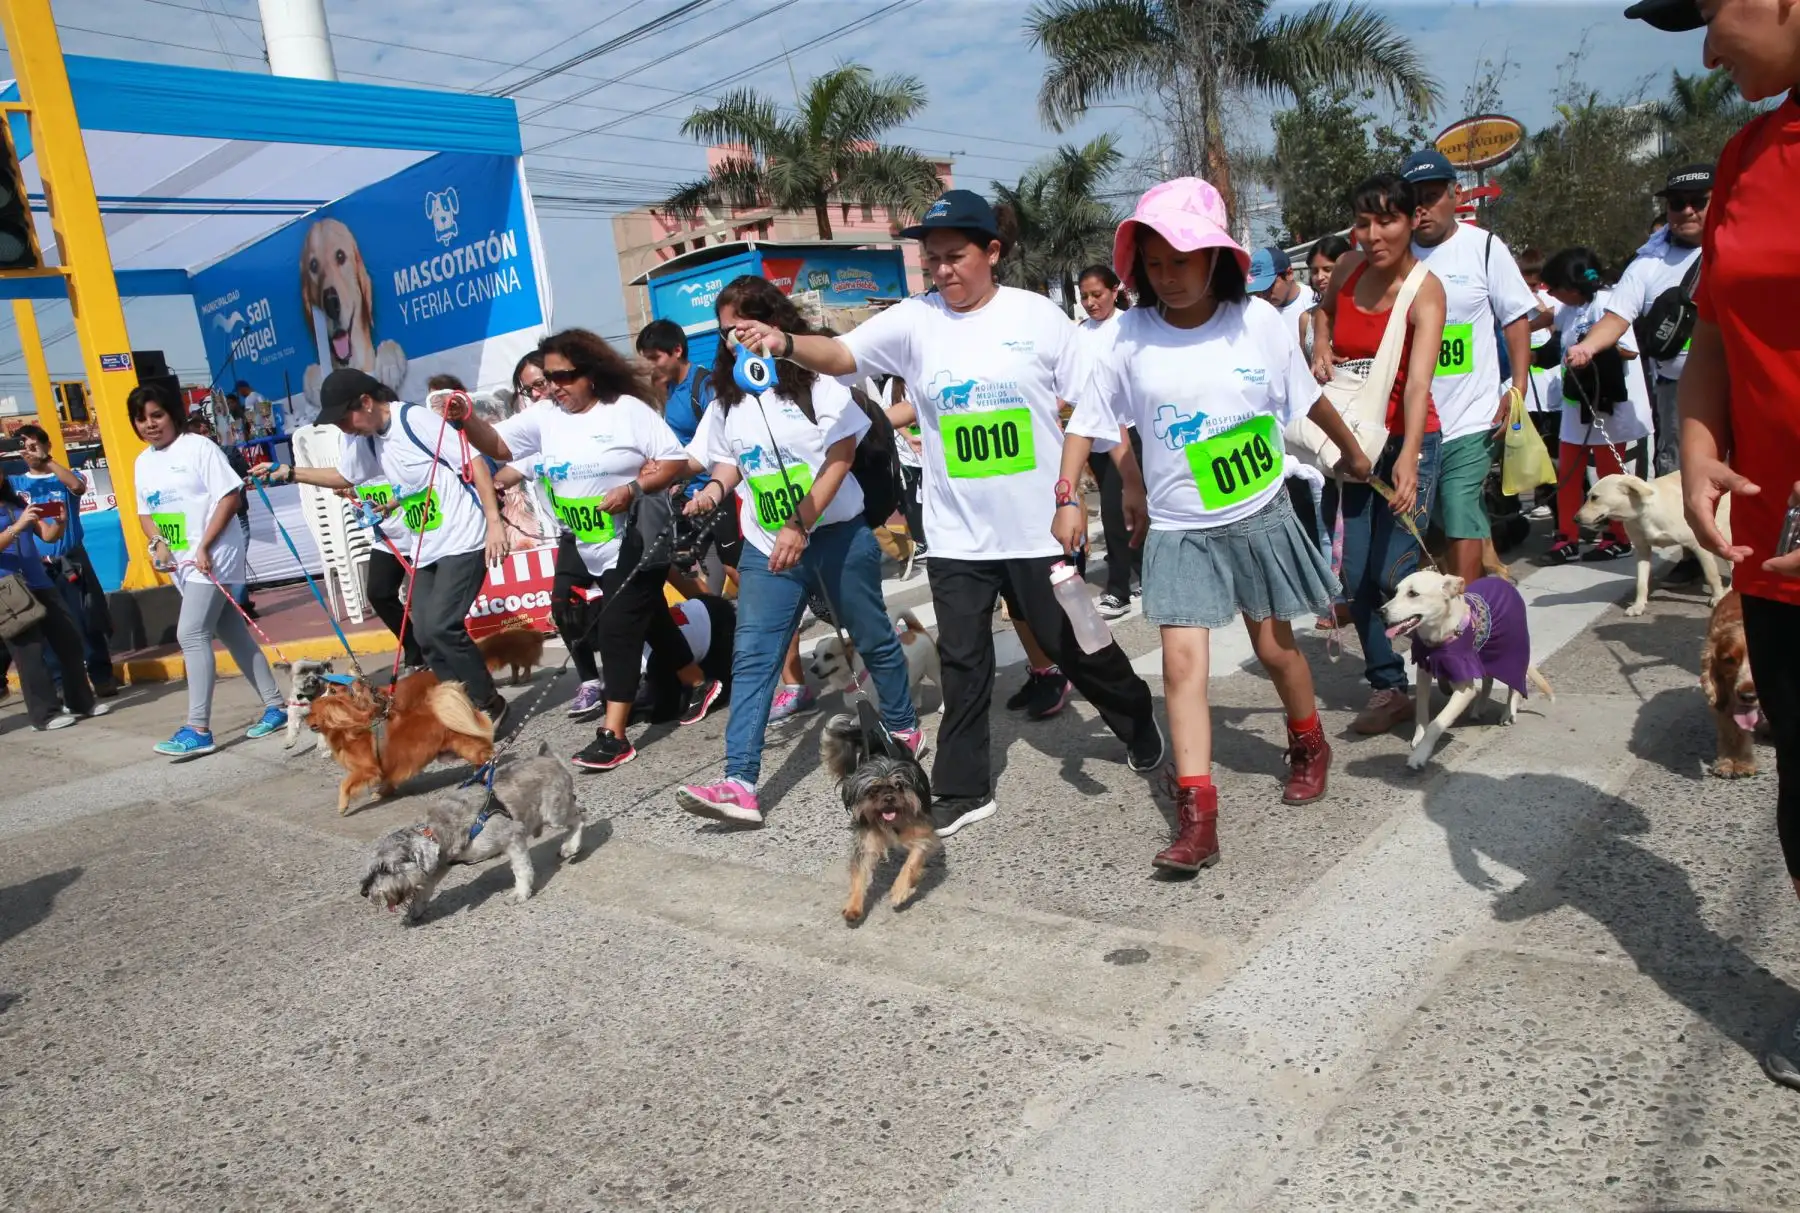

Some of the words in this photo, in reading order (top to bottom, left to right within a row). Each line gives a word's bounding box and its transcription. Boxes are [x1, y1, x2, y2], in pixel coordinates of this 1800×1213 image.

[393, 229, 518, 296] MASCOTATÓN
[705, 279, 723, 291] san
[808, 272, 830, 289] NUEVA
[399, 301, 408, 325] Y
[411, 288, 454, 322] FERIA
[455, 266, 522, 307] CANINA
[692, 291, 720, 308] migu
[246, 297, 271, 325] san
[231, 318, 277, 362] miguel
[1656, 318, 1675, 340] CAT
[1205, 410, 1256, 426] HOSPITALES
[955, 421, 1019, 462] 0010
[1211, 433, 1273, 494] 0119
[562, 505, 605, 531] 0034
[465, 590, 552, 619] icoca
